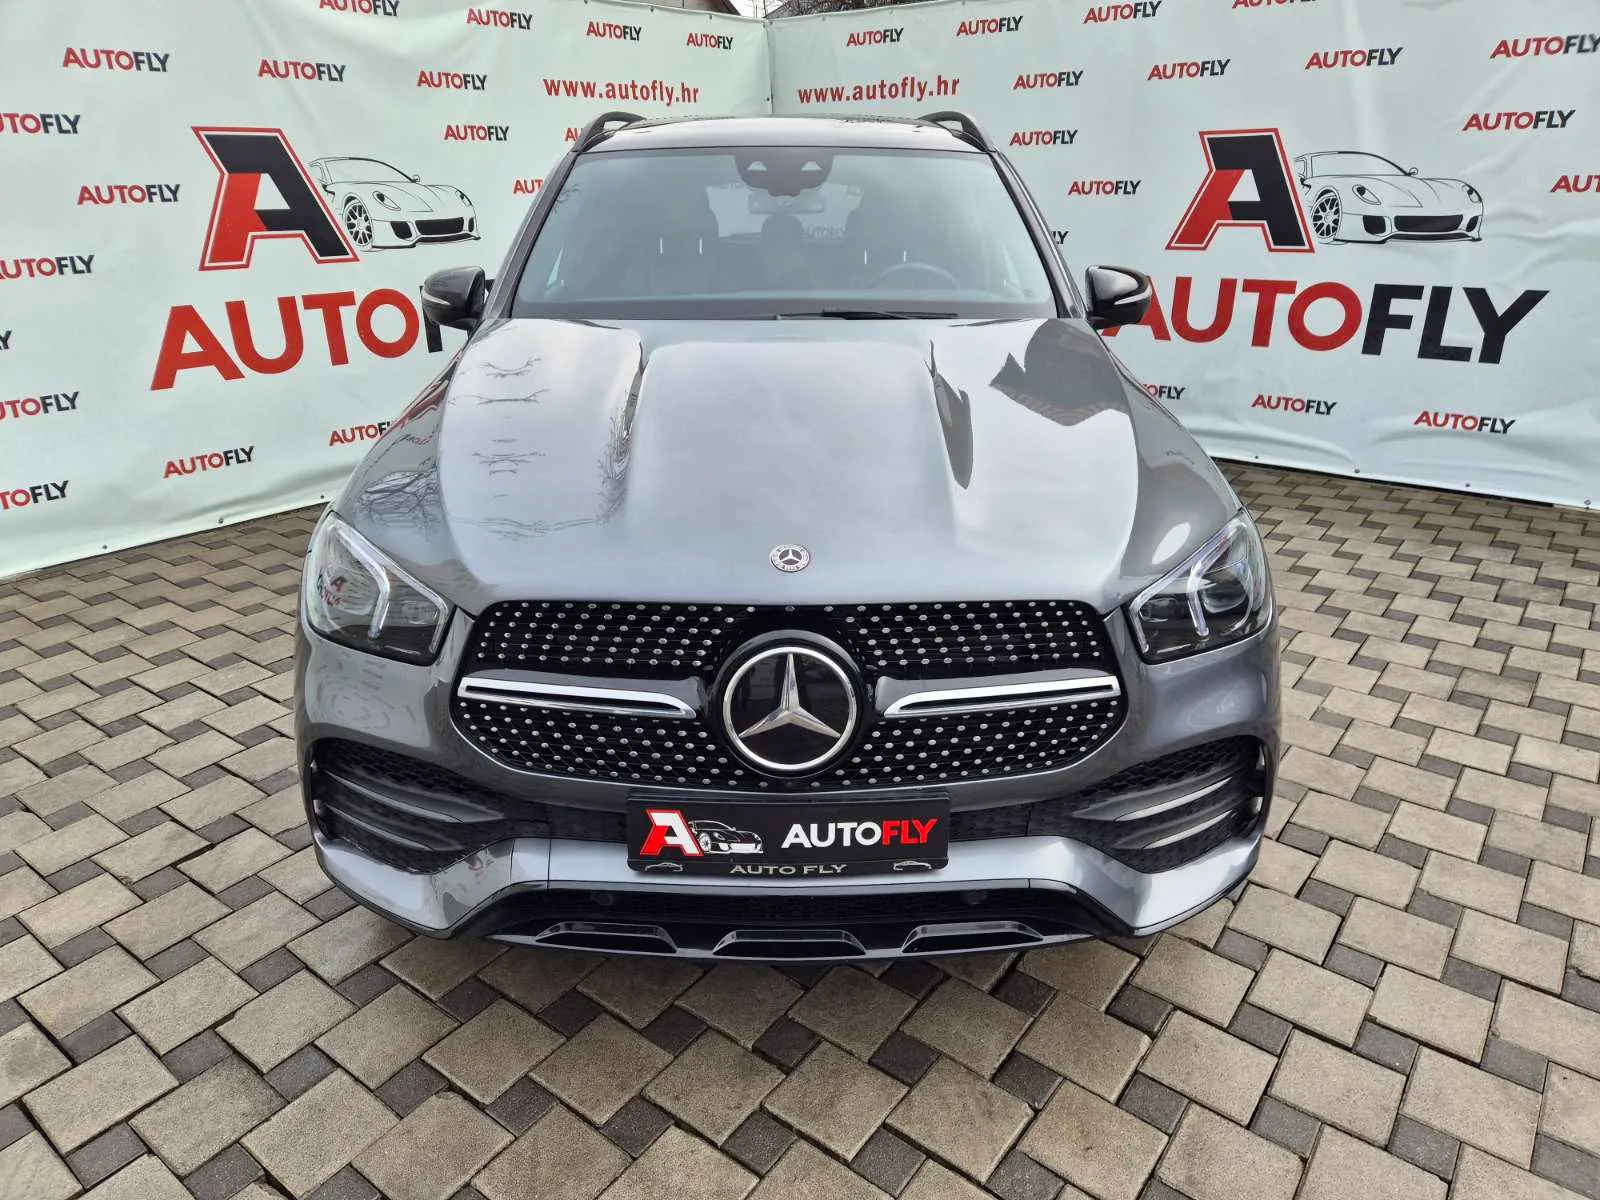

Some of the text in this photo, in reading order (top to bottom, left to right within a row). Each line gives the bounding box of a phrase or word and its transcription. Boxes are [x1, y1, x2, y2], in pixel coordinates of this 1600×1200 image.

[467, 9, 532, 30] AUTOFLY
[1083, 0, 1162, 25] AUTOFLY
[586, 21, 641, 41] AUTOFLY
[956, 16, 1023, 37] AUTOFLY
[686, 32, 733, 50] AUTOFLY
[846, 28, 904, 47] AUTOFLY
[62, 47, 170, 73] AUTOFLY
[1304, 47, 1403, 70] AUTOFLY
[258, 59, 346, 82] AUTOFLY
[1013, 70, 1084, 90] AUTOFLY
[1147, 58, 1231, 81] AUTOFLY
[417, 70, 487, 91] AUTOFLY
[798, 75, 960, 103] www.autofly.hr
[543, 79, 699, 107] www.autofly.hr
[0, 113, 80, 134] TOFLY
[1462, 110, 1576, 131] AUTOFLY
[444, 125, 509, 142] AUTOFLY
[1010, 130, 1079, 146] AUTOFLY
[77, 184, 181, 205] AUTOFLY
[1068, 180, 1142, 196] AUTOFLY
[1143, 383, 1186, 400] OFLY
[1252, 394, 1338, 416] AUTOFLY
[1414, 410, 1516, 435] AUTOFLY
[164, 446, 255, 479] AUTOFLY
[781, 818, 938, 849] AUTOFLY
[730, 864, 847, 875] AUTO FLY
